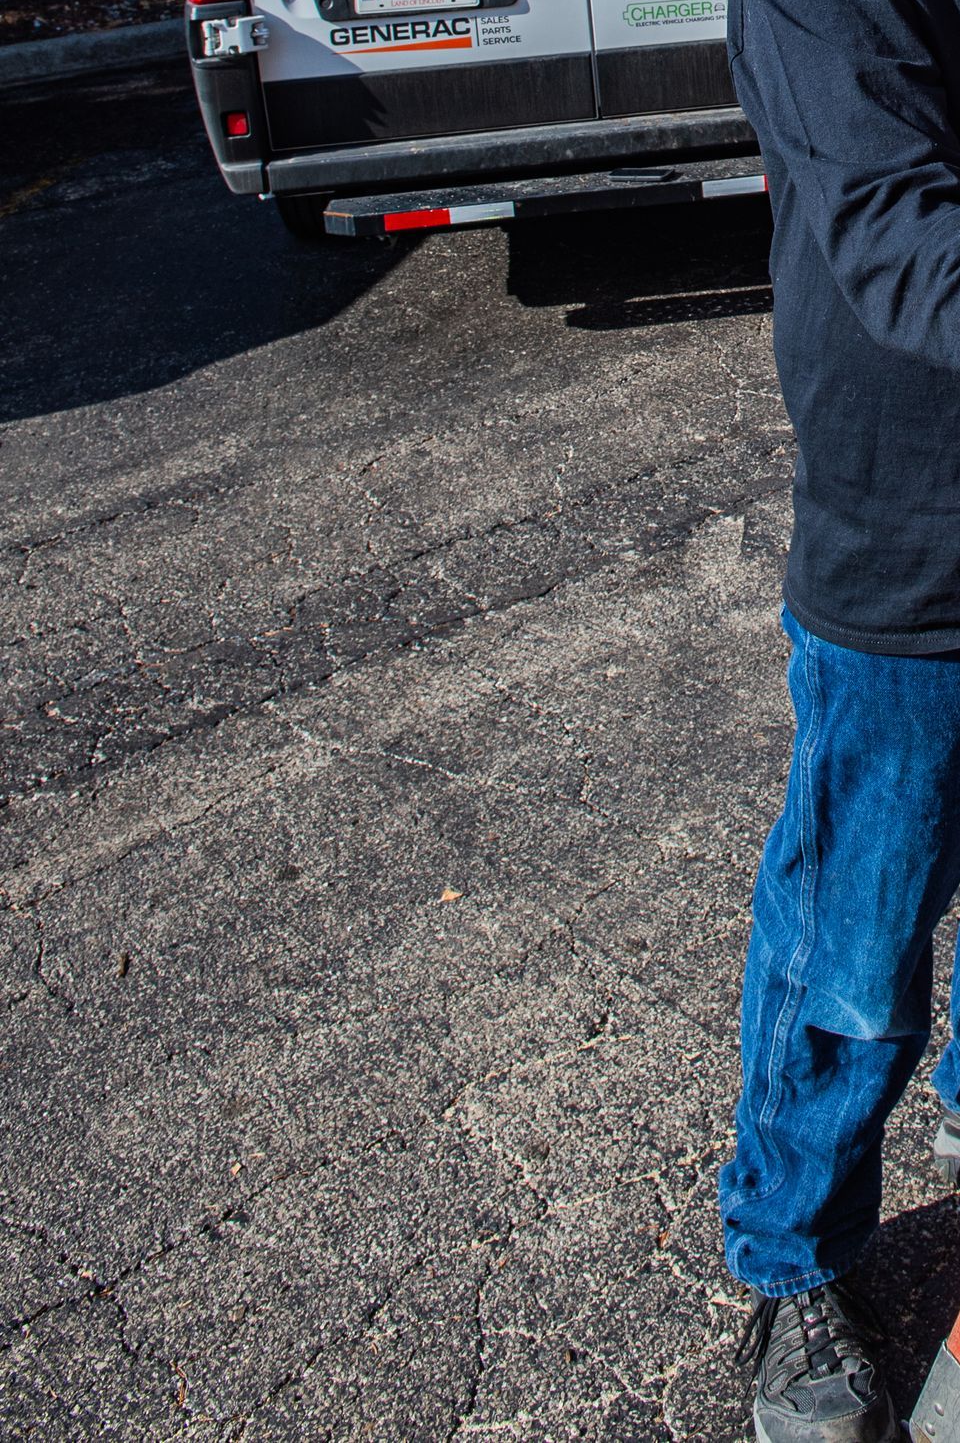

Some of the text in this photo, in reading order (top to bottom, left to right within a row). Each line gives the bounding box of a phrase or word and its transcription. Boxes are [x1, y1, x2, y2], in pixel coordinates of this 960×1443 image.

[390, 0, 409, 8] LAND
[630, 1, 713, 22] CHARGER
[480, 15, 510, 25] SALES
[635, 19, 661, 28] ELECTRIC
[662, 18, 685, 26] VEHICLE
[685, 15, 715, 24] CHARGING
[329, 16, 472, 46] GENERAC
[482, 25, 512, 35] PARTS
[482, 35, 522, 45] SERVICE
